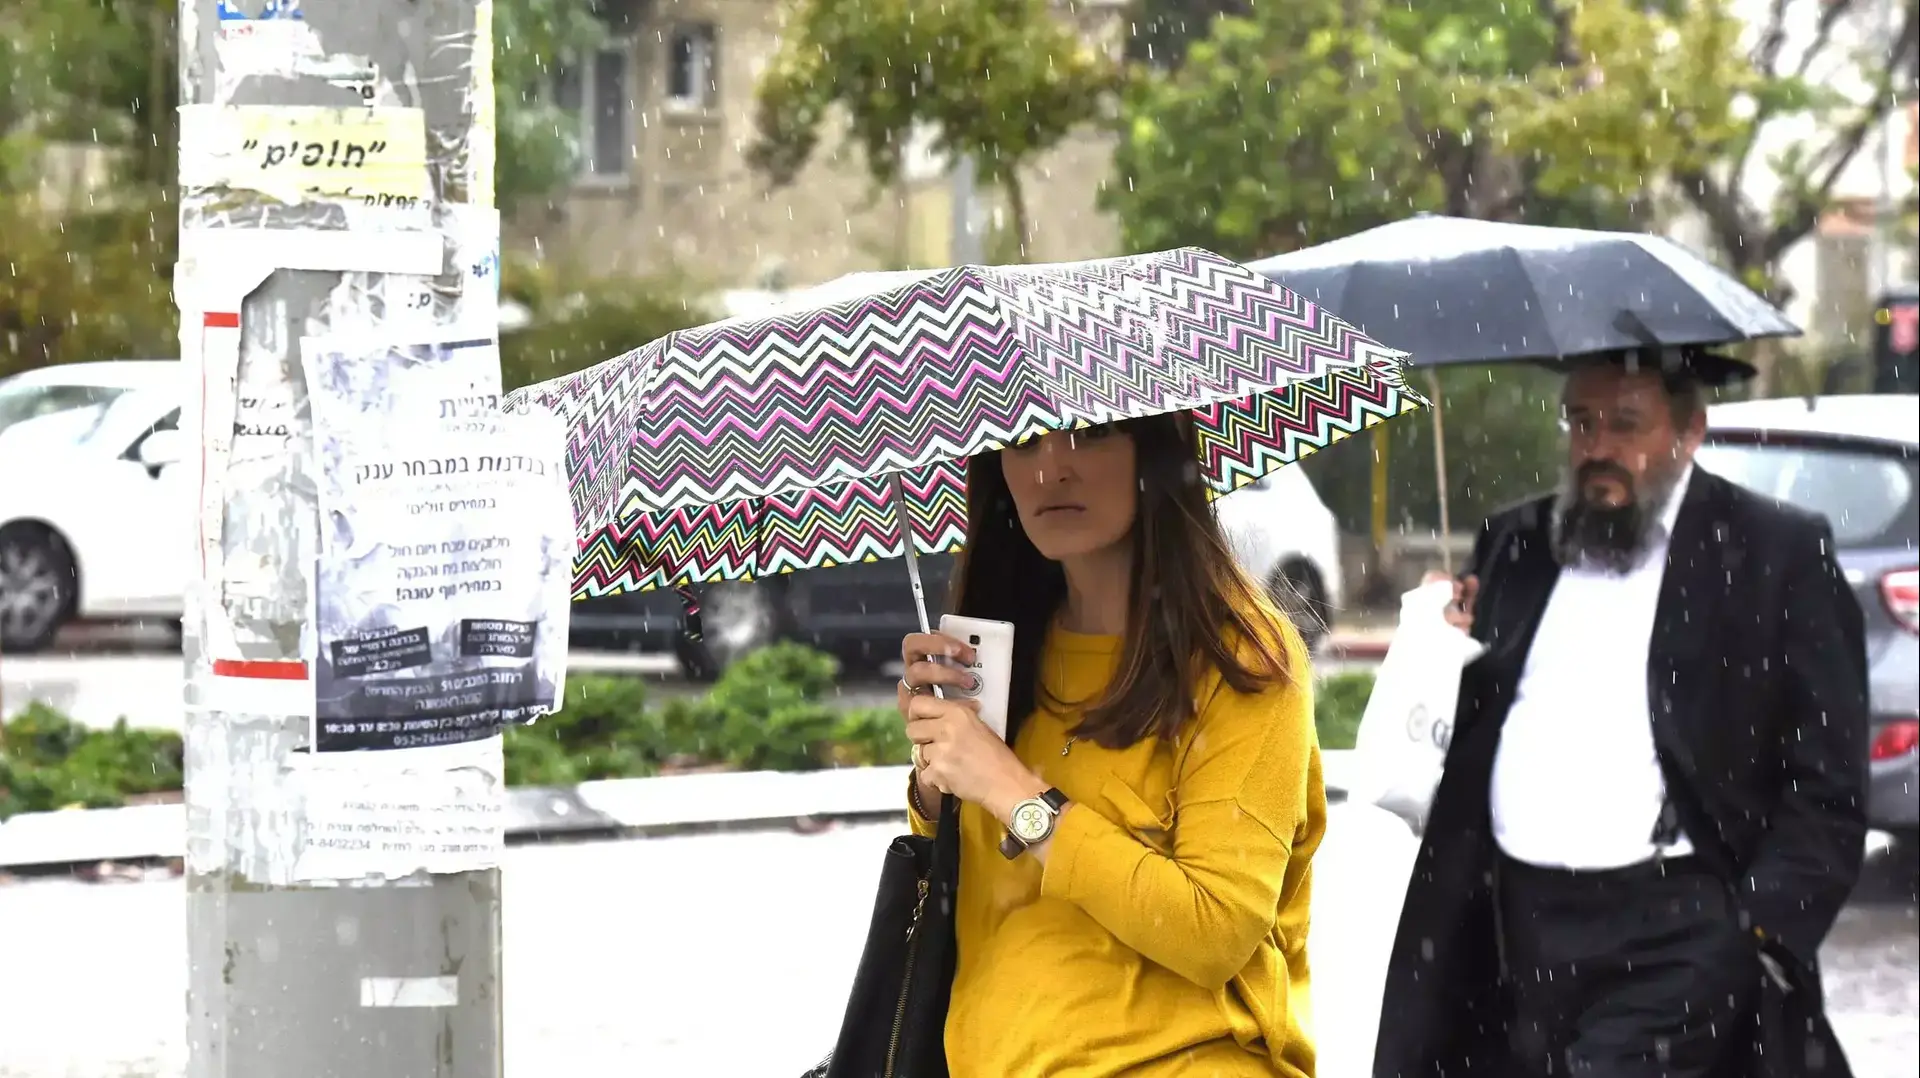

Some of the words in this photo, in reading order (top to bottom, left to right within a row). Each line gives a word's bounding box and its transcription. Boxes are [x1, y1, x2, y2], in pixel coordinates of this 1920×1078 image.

[354, 463, 393, 485] ענק
[402, 457, 469, 477] במבחר
[477, 456, 545, 476] בנדנות
[449, 498, 496, 512] במחירים
[396, 587, 434, 602] עונה!
